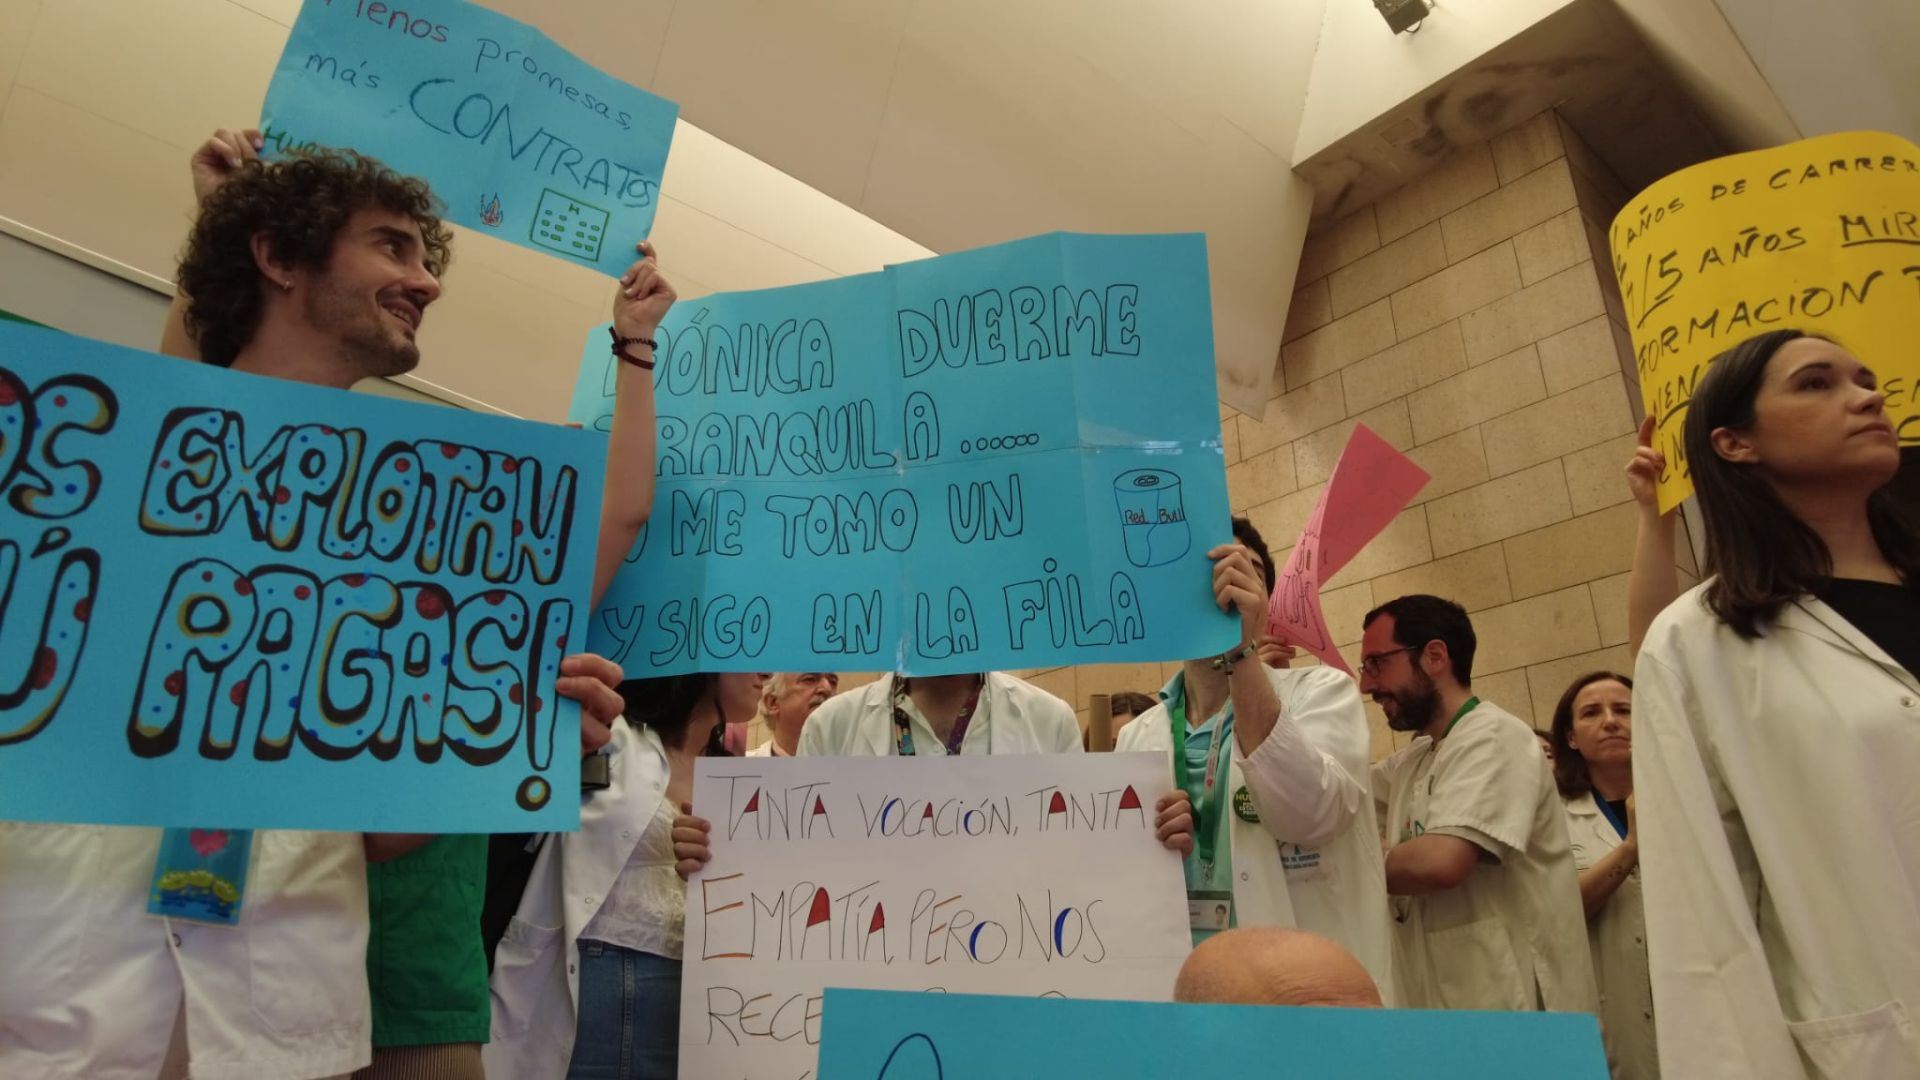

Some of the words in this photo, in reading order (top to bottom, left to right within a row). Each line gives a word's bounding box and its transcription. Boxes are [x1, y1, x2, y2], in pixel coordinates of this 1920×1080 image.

[305, 54, 380, 88] más
[1626, 197, 1685, 250] AÑOS
[1710, 178, 1746, 200] DE
[1698, 226, 1806, 273] AÑOS
[897, 283, 1141, 378] DUERME
[1639, 270, 1884, 381] FORMACION
[139, 406, 577, 585] EXPLOTAN
[671, 487, 746, 556] ME
[765, 488, 918, 559] TOMO
[949, 473, 1024, 544] UN
[1124, 507, 1147, 526] Red
[602, 605, 645, 664] Y
[650, 594, 770, 667] SIGO
[811, 589, 882, 655] EN
[916, 586, 979, 659] LA
[126, 557, 574, 811] PAGAS!
[707, 775, 834, 841] TANTA
[1025, 784, 1147, 832] TANTA
[909, 888, 1007, 965] PERO
[1017, 889, 1106, 964] NOS
